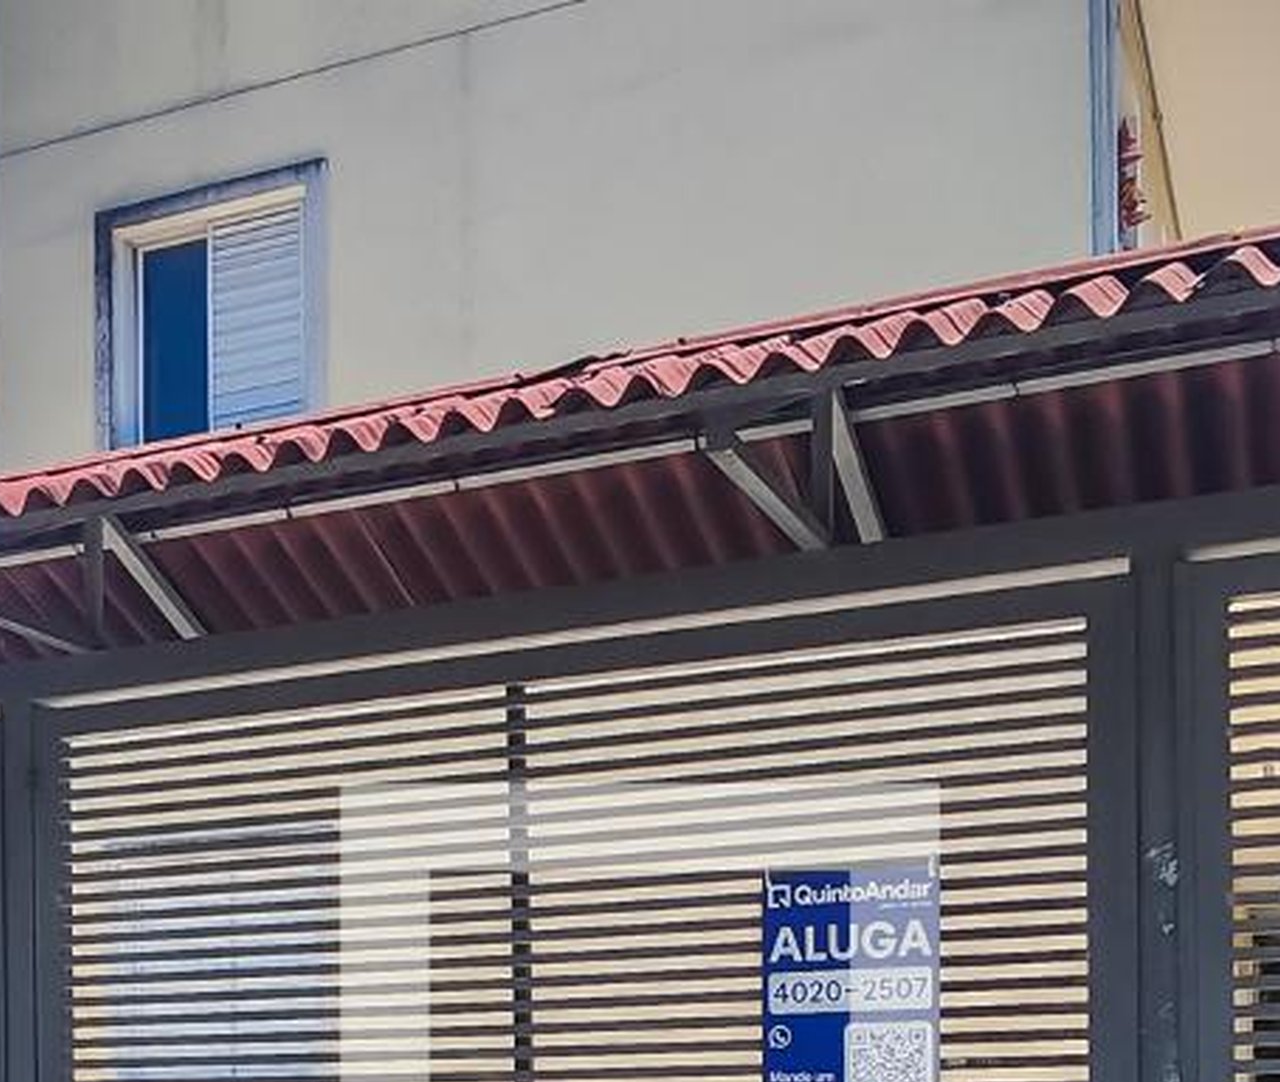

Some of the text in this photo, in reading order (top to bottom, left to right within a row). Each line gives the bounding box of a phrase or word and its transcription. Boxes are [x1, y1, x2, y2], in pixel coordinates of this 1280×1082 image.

[794, 879, 932, 905] QuintoAndar
[770, 919, 932, 963] ALUGA
[773, 977, 928, 1003] 4020-2507
